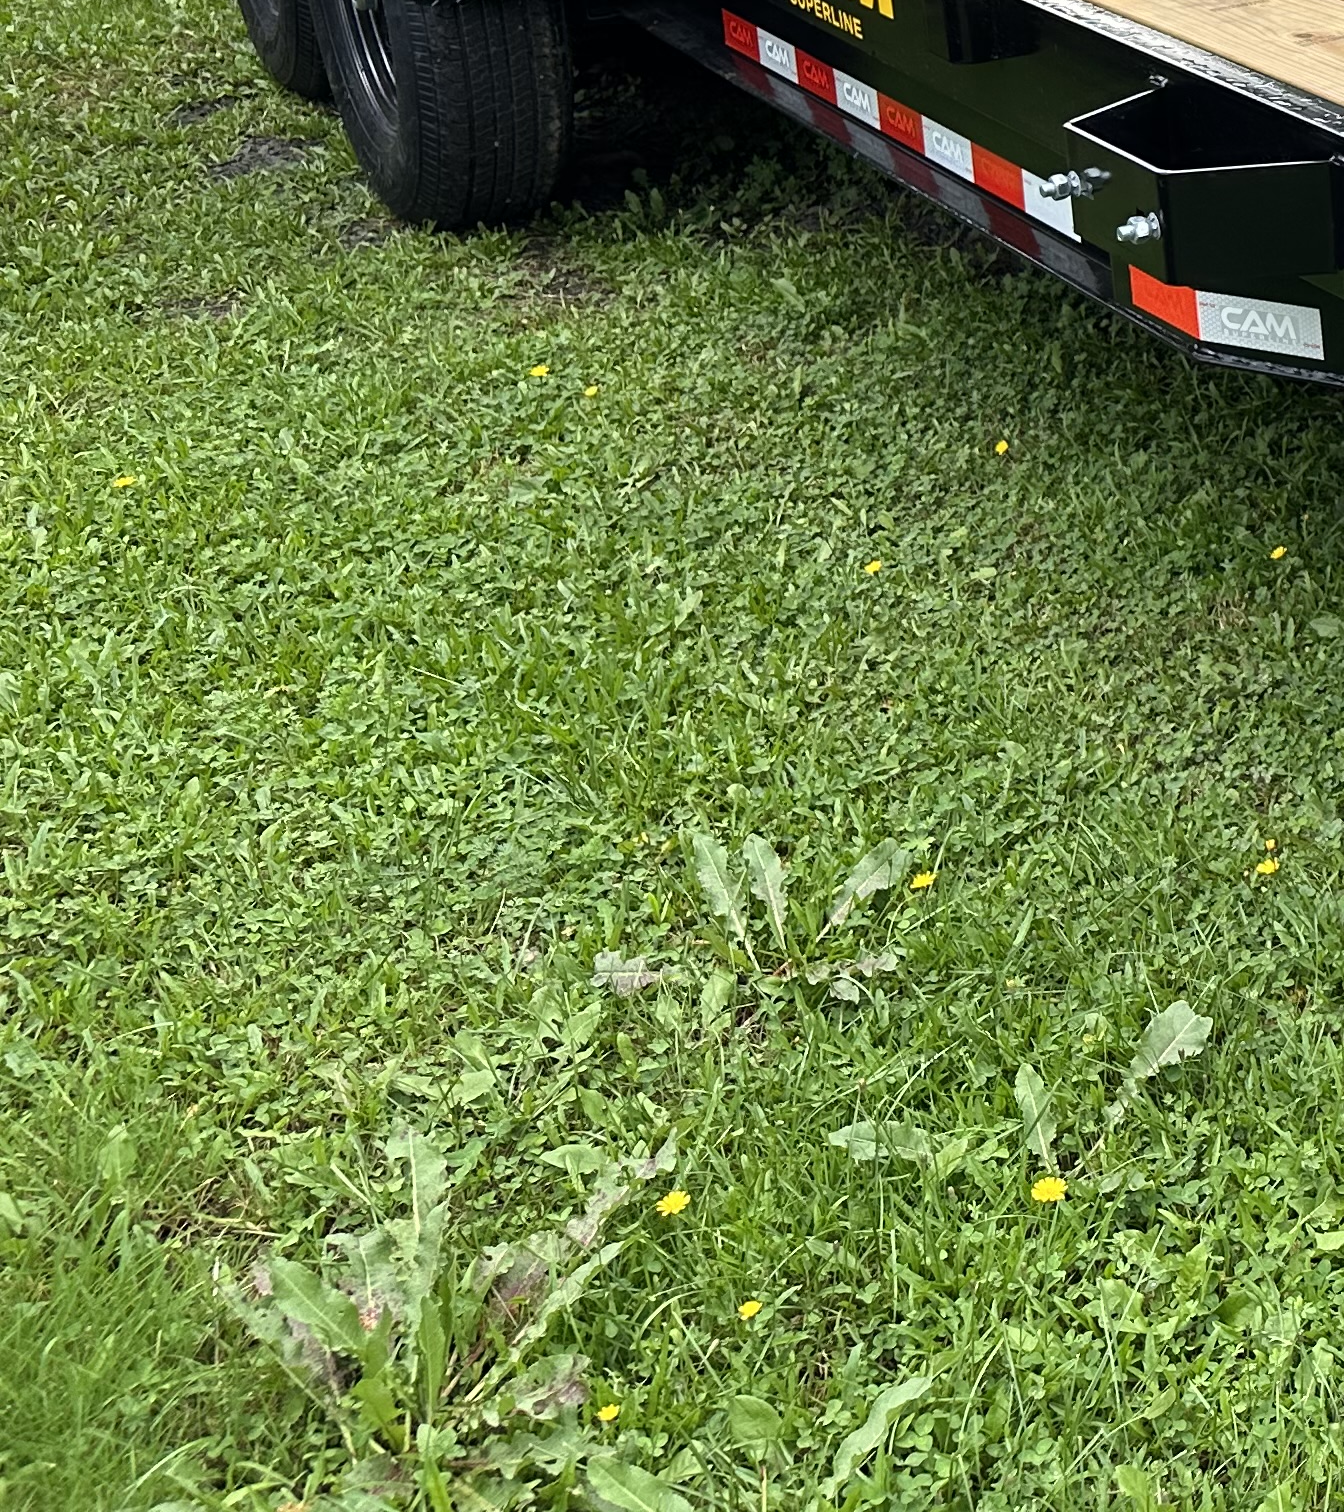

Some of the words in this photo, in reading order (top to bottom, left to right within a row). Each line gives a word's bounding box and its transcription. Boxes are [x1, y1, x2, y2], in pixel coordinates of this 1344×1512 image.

[729, 21, 754, 48] CAM
[765, 40, 790, 67] CAM
[803, 60, 830, 88] CAM
[843, 82, 872, 112] CAM
[886, 105, 916, 137] CAM
[932, 131, 964, 161] CAM
[1220, 306, 1297, 339] CAM
